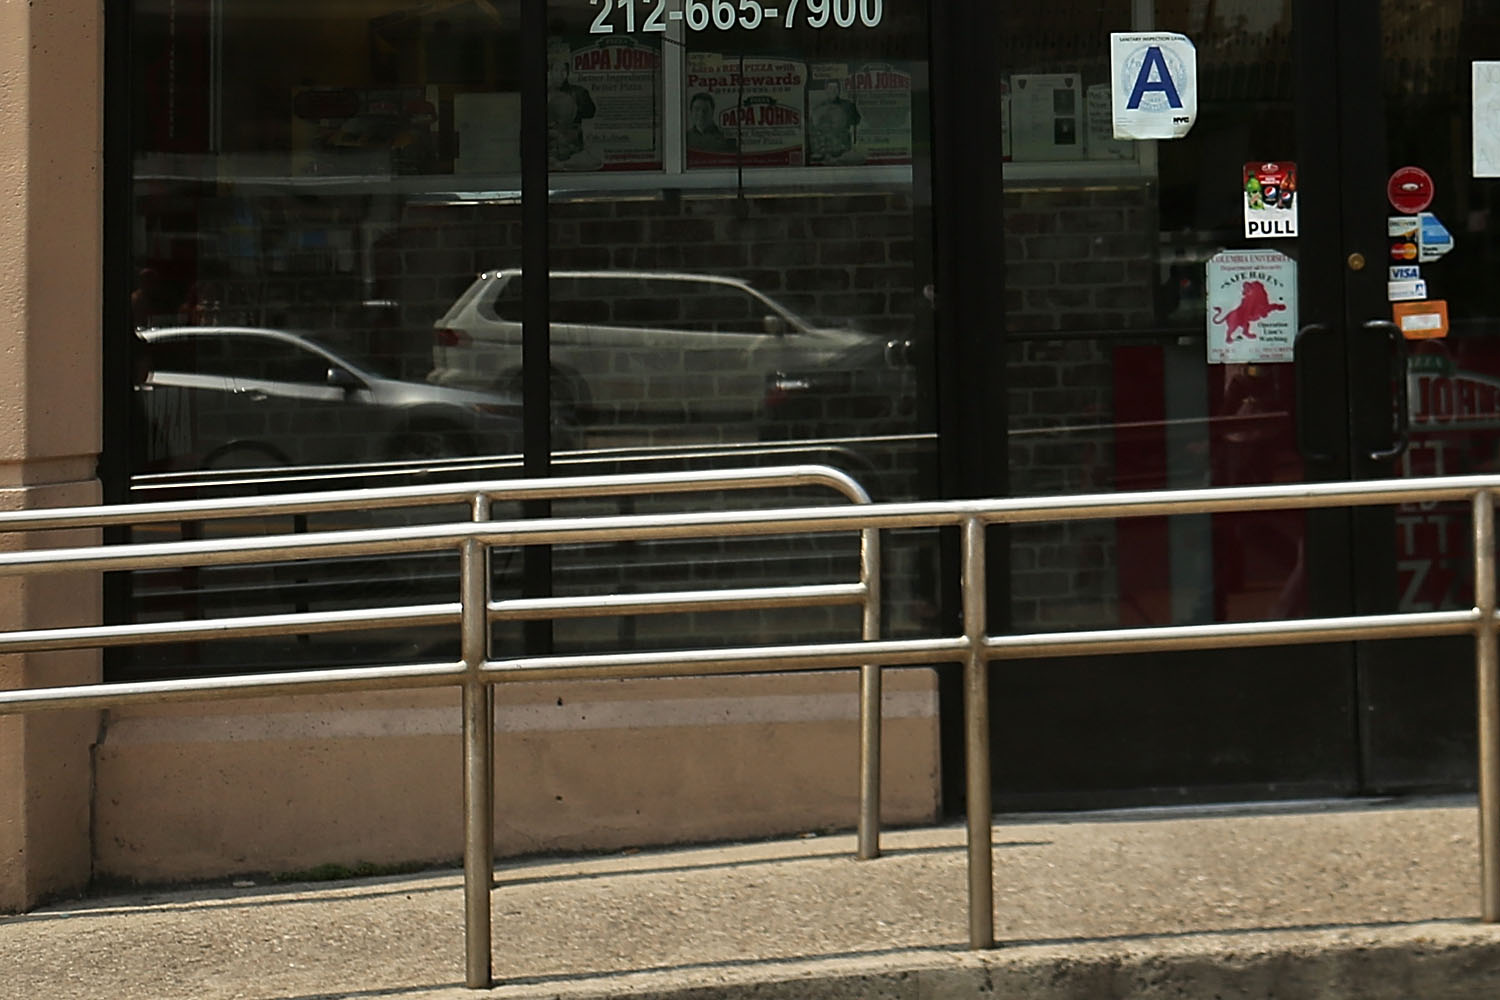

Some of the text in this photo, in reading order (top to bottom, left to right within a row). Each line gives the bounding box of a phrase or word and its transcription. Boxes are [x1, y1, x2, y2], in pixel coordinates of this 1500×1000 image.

[574, 48, 611, 70] PAPA
[1126, 46, 1184, 110] A
[1248, 219, 1295, 235] PULL
[1391, 267, 1418, 278] VISA
